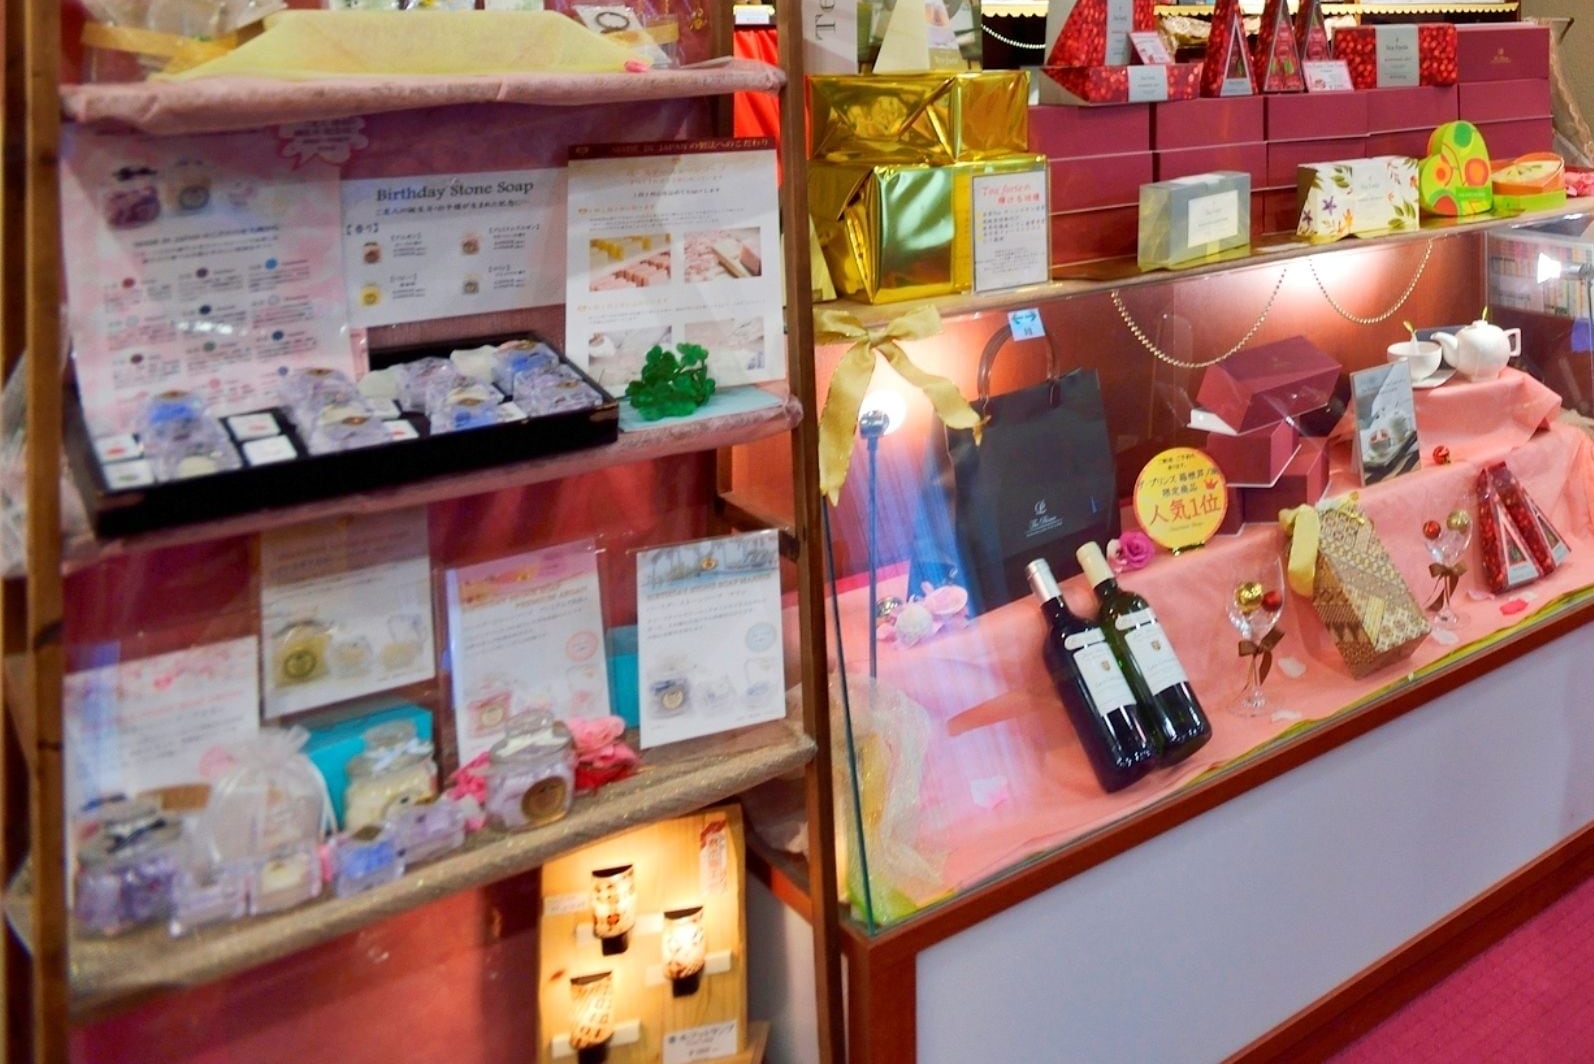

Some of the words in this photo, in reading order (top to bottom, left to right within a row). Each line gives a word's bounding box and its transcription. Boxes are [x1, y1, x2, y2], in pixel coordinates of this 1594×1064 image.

[376, 186, 447, 202] Birthday
[450, 182, 493, 197] Stone
[497, 180, 534, 196] Soap
[1150, 492, 1222, 526] 人気1位
